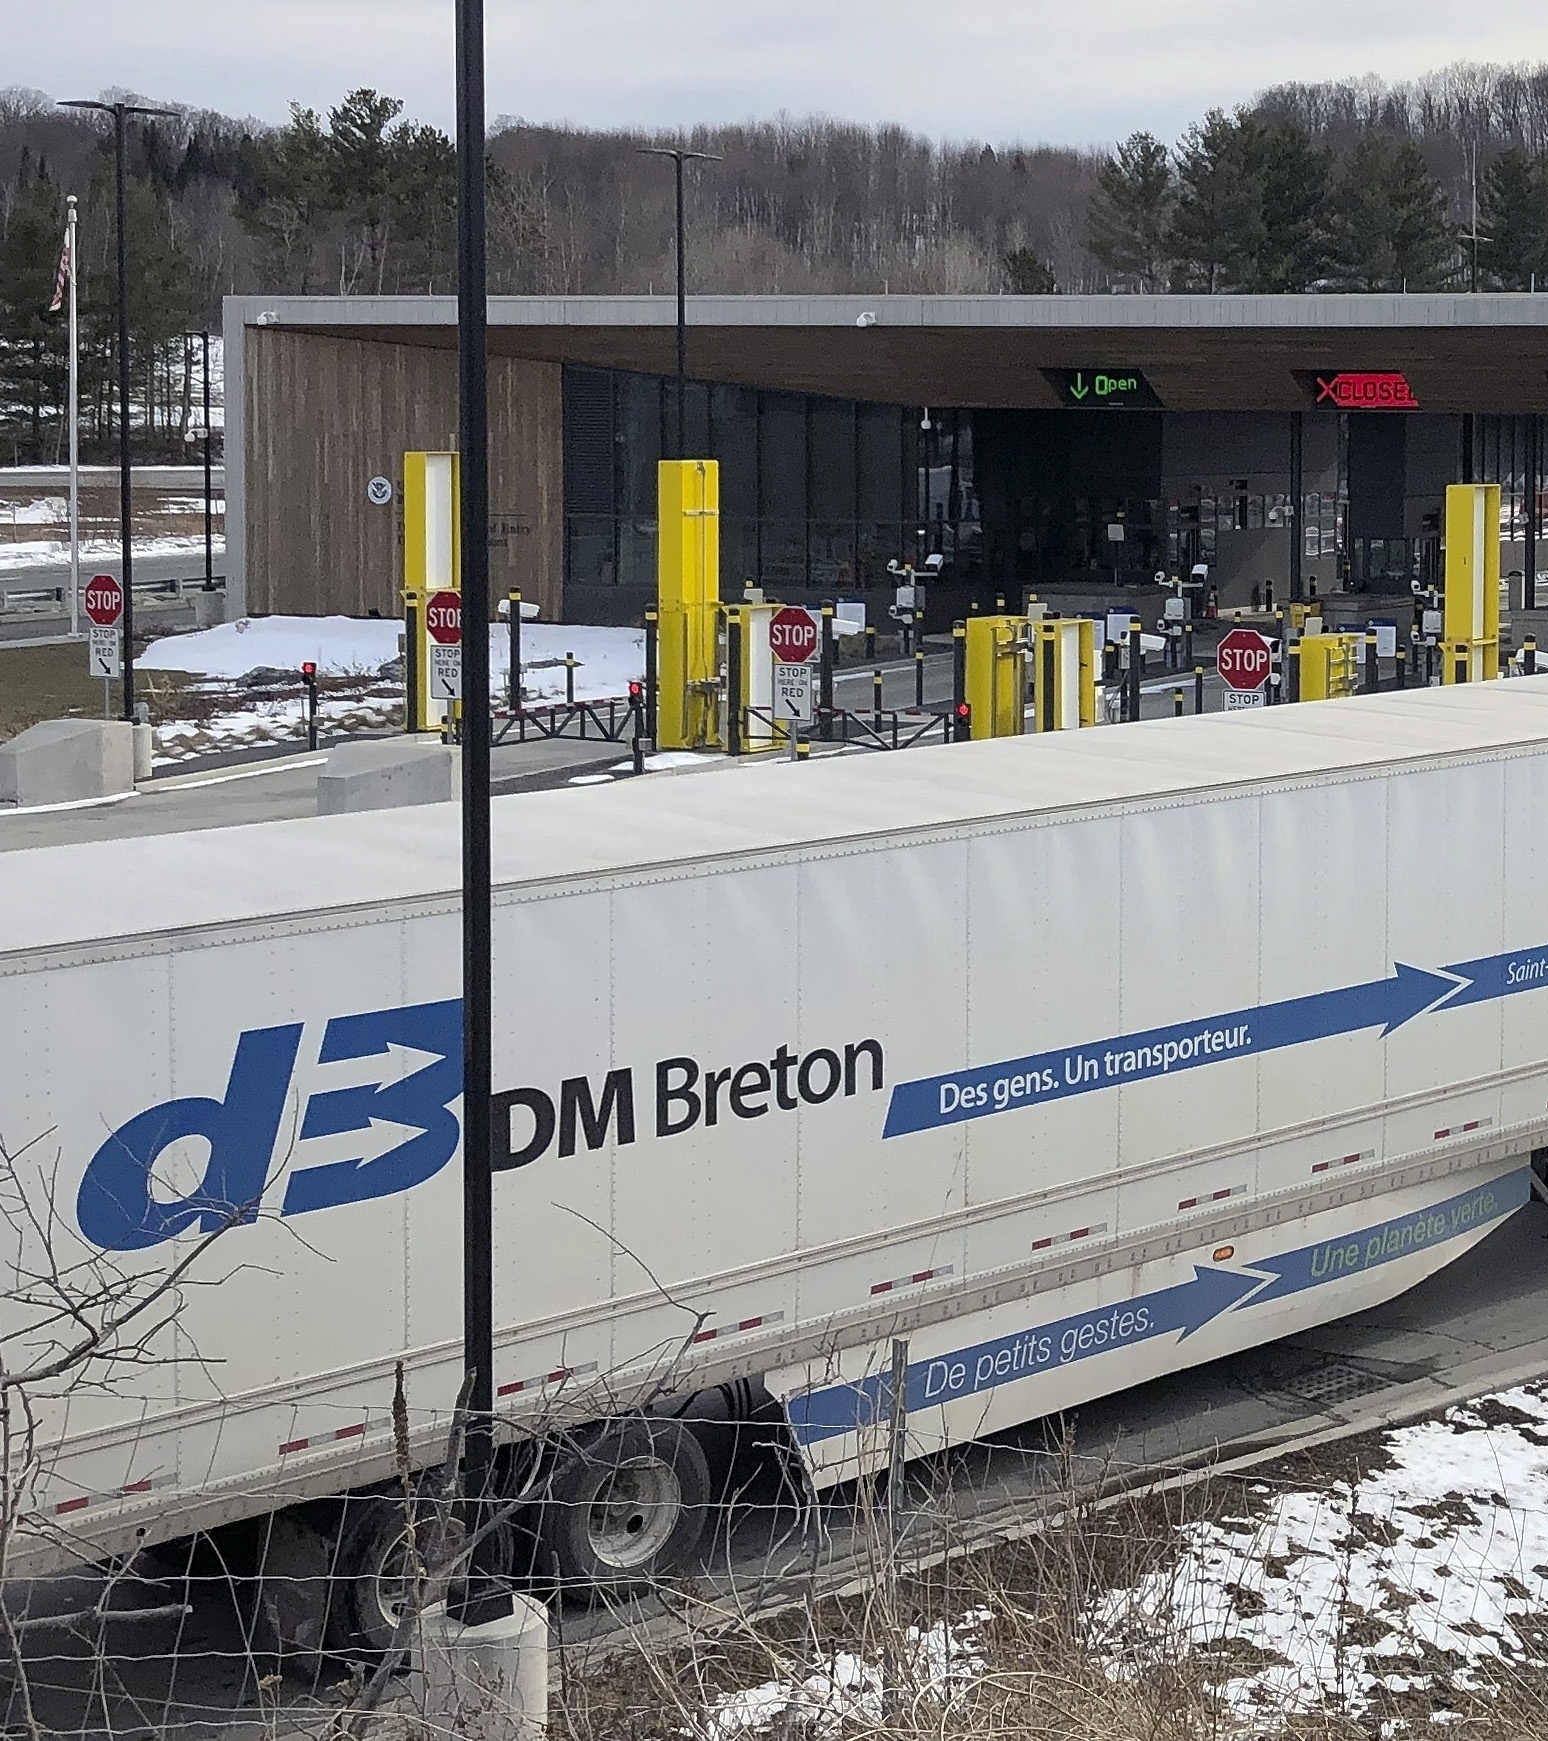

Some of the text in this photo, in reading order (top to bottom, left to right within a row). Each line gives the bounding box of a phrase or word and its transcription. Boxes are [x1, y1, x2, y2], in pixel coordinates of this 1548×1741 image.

[1095, 375, 1137, 395] Open
[87, 589, 121, 611] STOP
[93, 629, 116, 639] STOP
[771, 624, 815, 647] STOP
[95, 648, 114, 657] RED
[435, 648, 461, 659] STOP
[1221, 648, 1268, 672] STOP
[437, 667, 458, 678] RED
[778, 667, 807, 678] STOP
[781, 687, 804, 698] RED
[1228, 693, 1260, 705] STOP
[939, 1024, 1253, 1115] Des gens. Un transporteur.
[490, 1038, 884, 1173] DM Breton
[1311, 1191, 1499, 1277] Une planète verte.
[925, 1306, 1155, 1399] De petits gestes.
